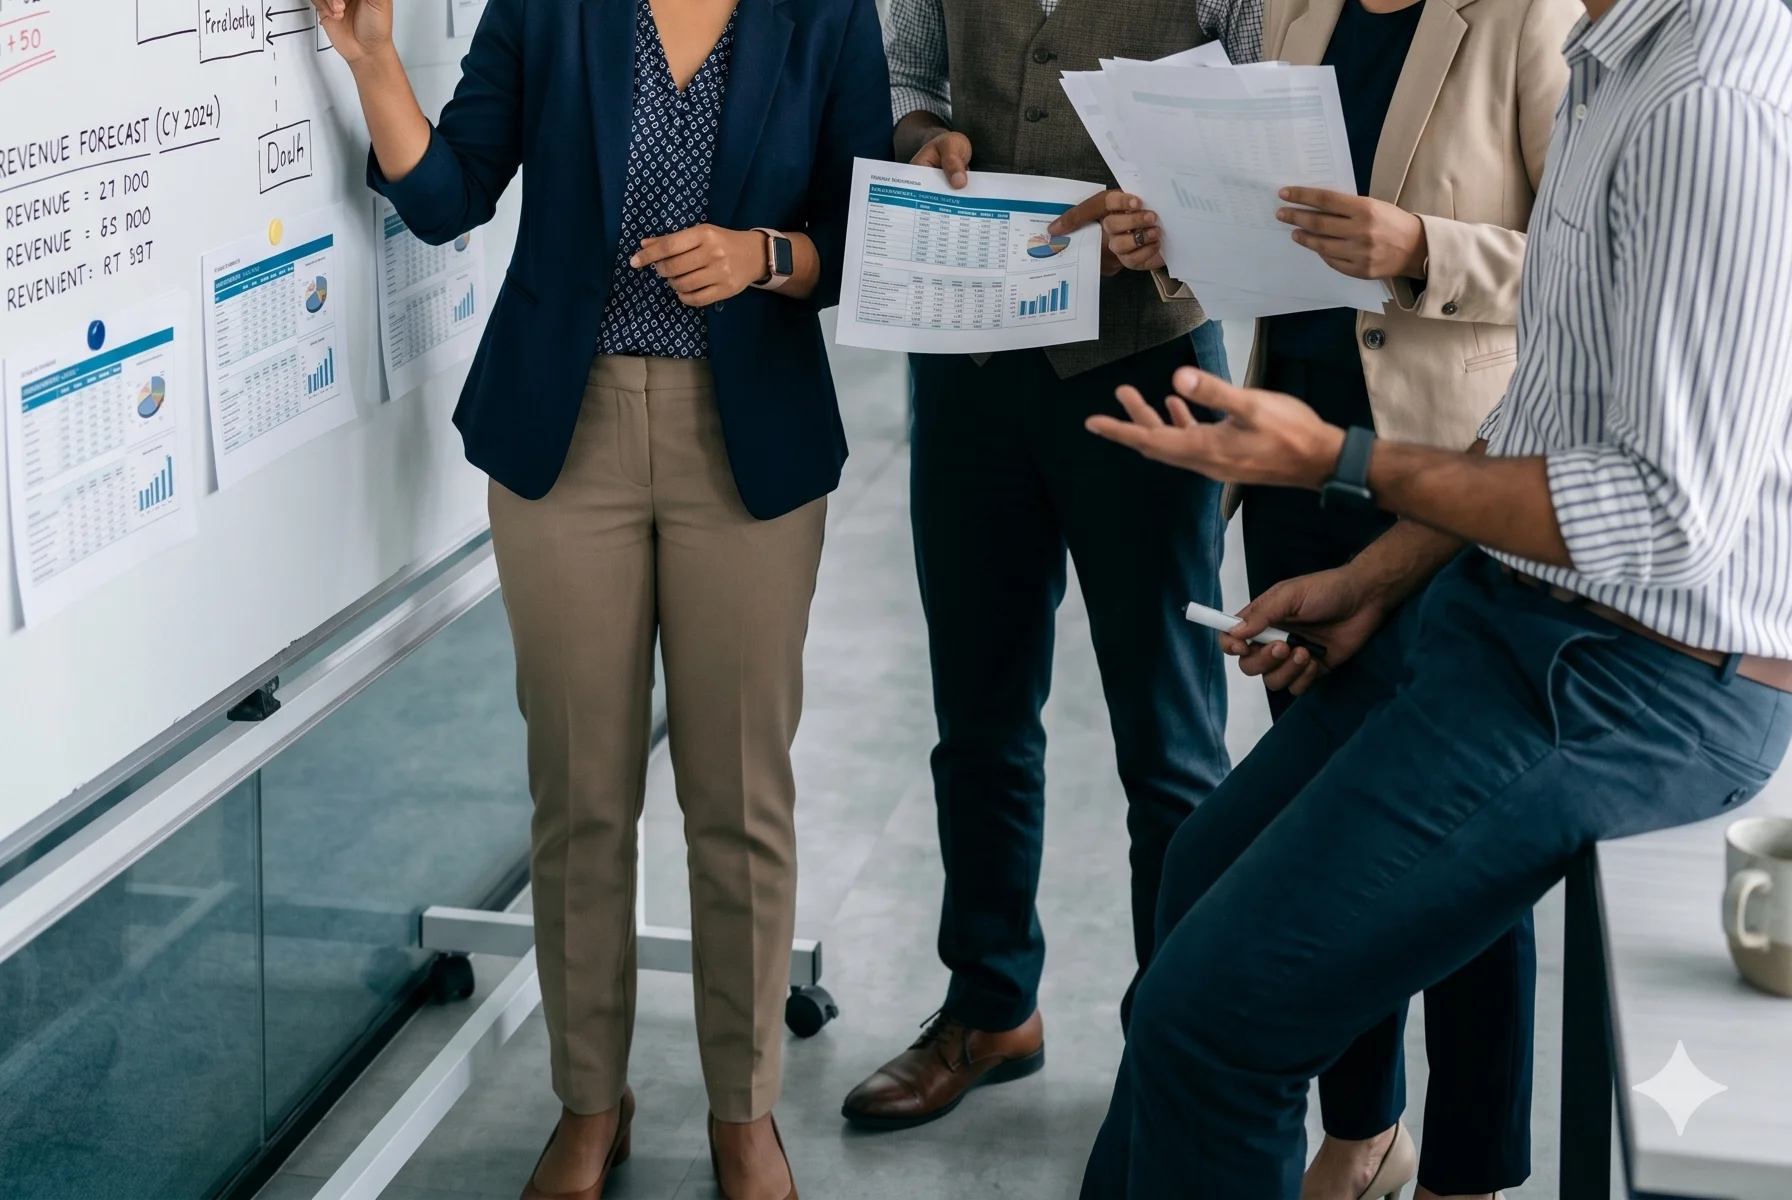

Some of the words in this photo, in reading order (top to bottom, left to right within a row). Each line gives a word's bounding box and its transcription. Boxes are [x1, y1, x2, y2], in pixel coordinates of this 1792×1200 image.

[20, 28, 41, 51] 50
[0, 134, 70, 180] REVENUE
[79, 117, 150, 156] FORECAST
[156, 106, 180, 145] (CY
[184, 94, 221, 130] 2024)
[6, 190, 71, 229] REVENUE
[99, 179, 115, 201] 27
[6, 229, 72, 269] REVENUE
[103, 251, 121, 275] RT
